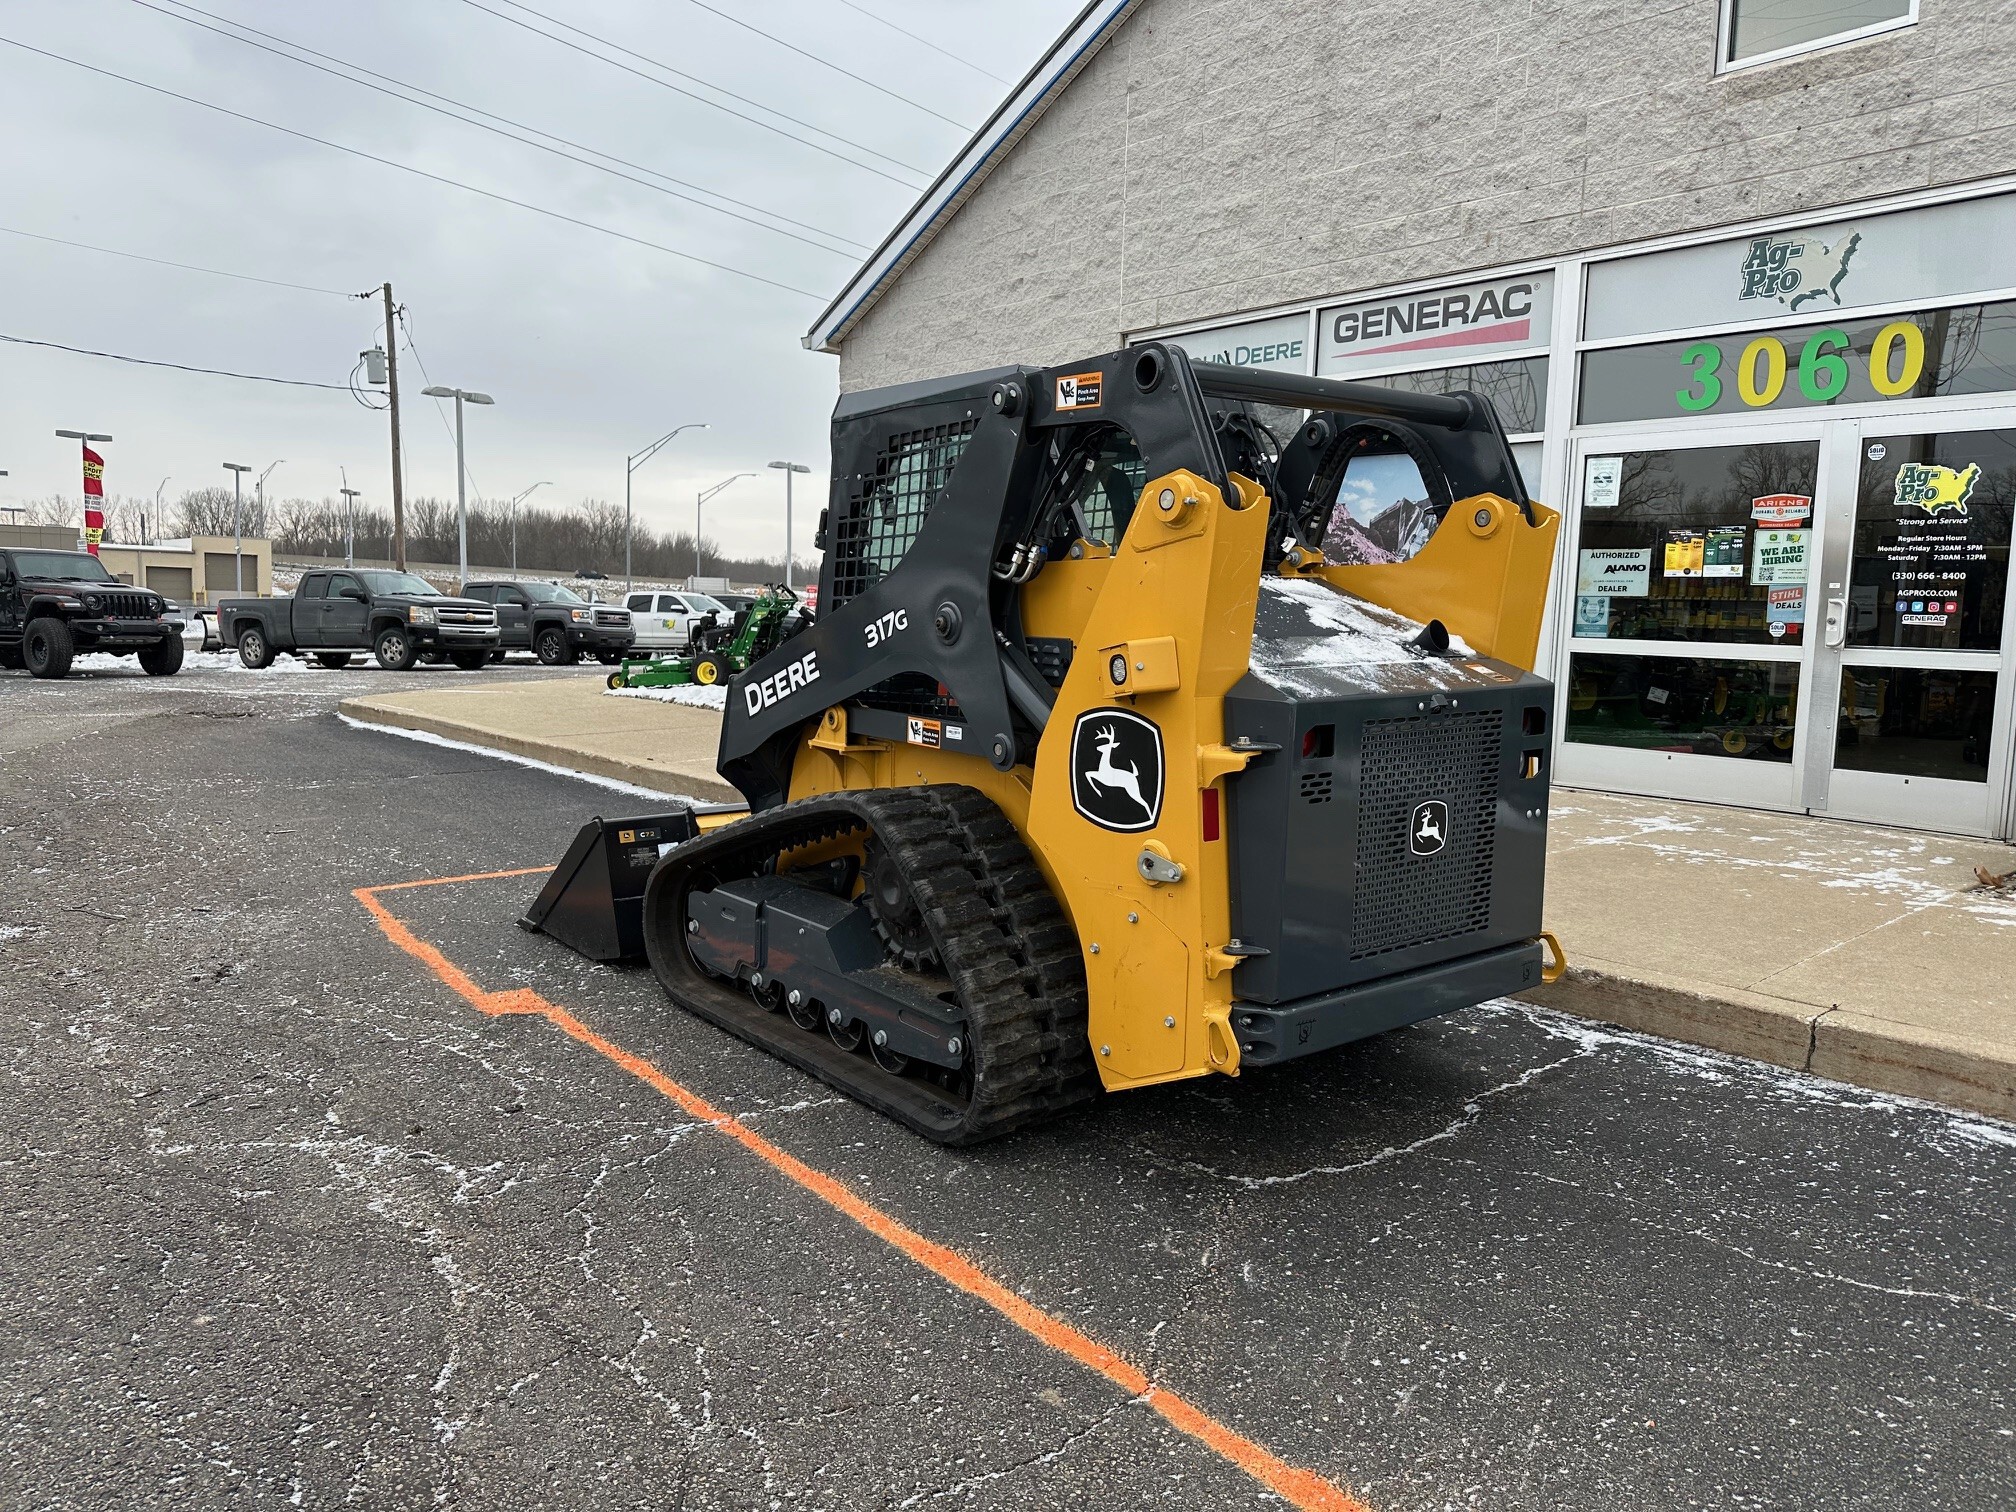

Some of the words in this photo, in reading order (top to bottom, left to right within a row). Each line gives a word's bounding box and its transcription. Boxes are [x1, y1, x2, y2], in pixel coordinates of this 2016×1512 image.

[1742, 237, 1804, 271] Ag-
[1740, 268, 1802, 300] Pro
[1333, 283, 1532, 343] GENERAC
[1234, 340, 1303, 366] DEERE
[1676, 321, 1925, 411] 3060
[1899, 465, 1940, 486] Ag-
[1897, 484, 1938, 502] Pro
[1896, 518, 1925, 526] "Strong
[1760, 548, 1779, 556] WE
[1781, 545, 1804, 555] ARE
[1762, 555, 1803, 565] HIRING
[1603, 564, 1646, 574] ALAMO
[1892, 572, 1916, 580] (330)
[1771, 590, 1801, 600] STIHL
[864, 608, 908, 648] 317G
[744, 650, 821, 717] DEERE
